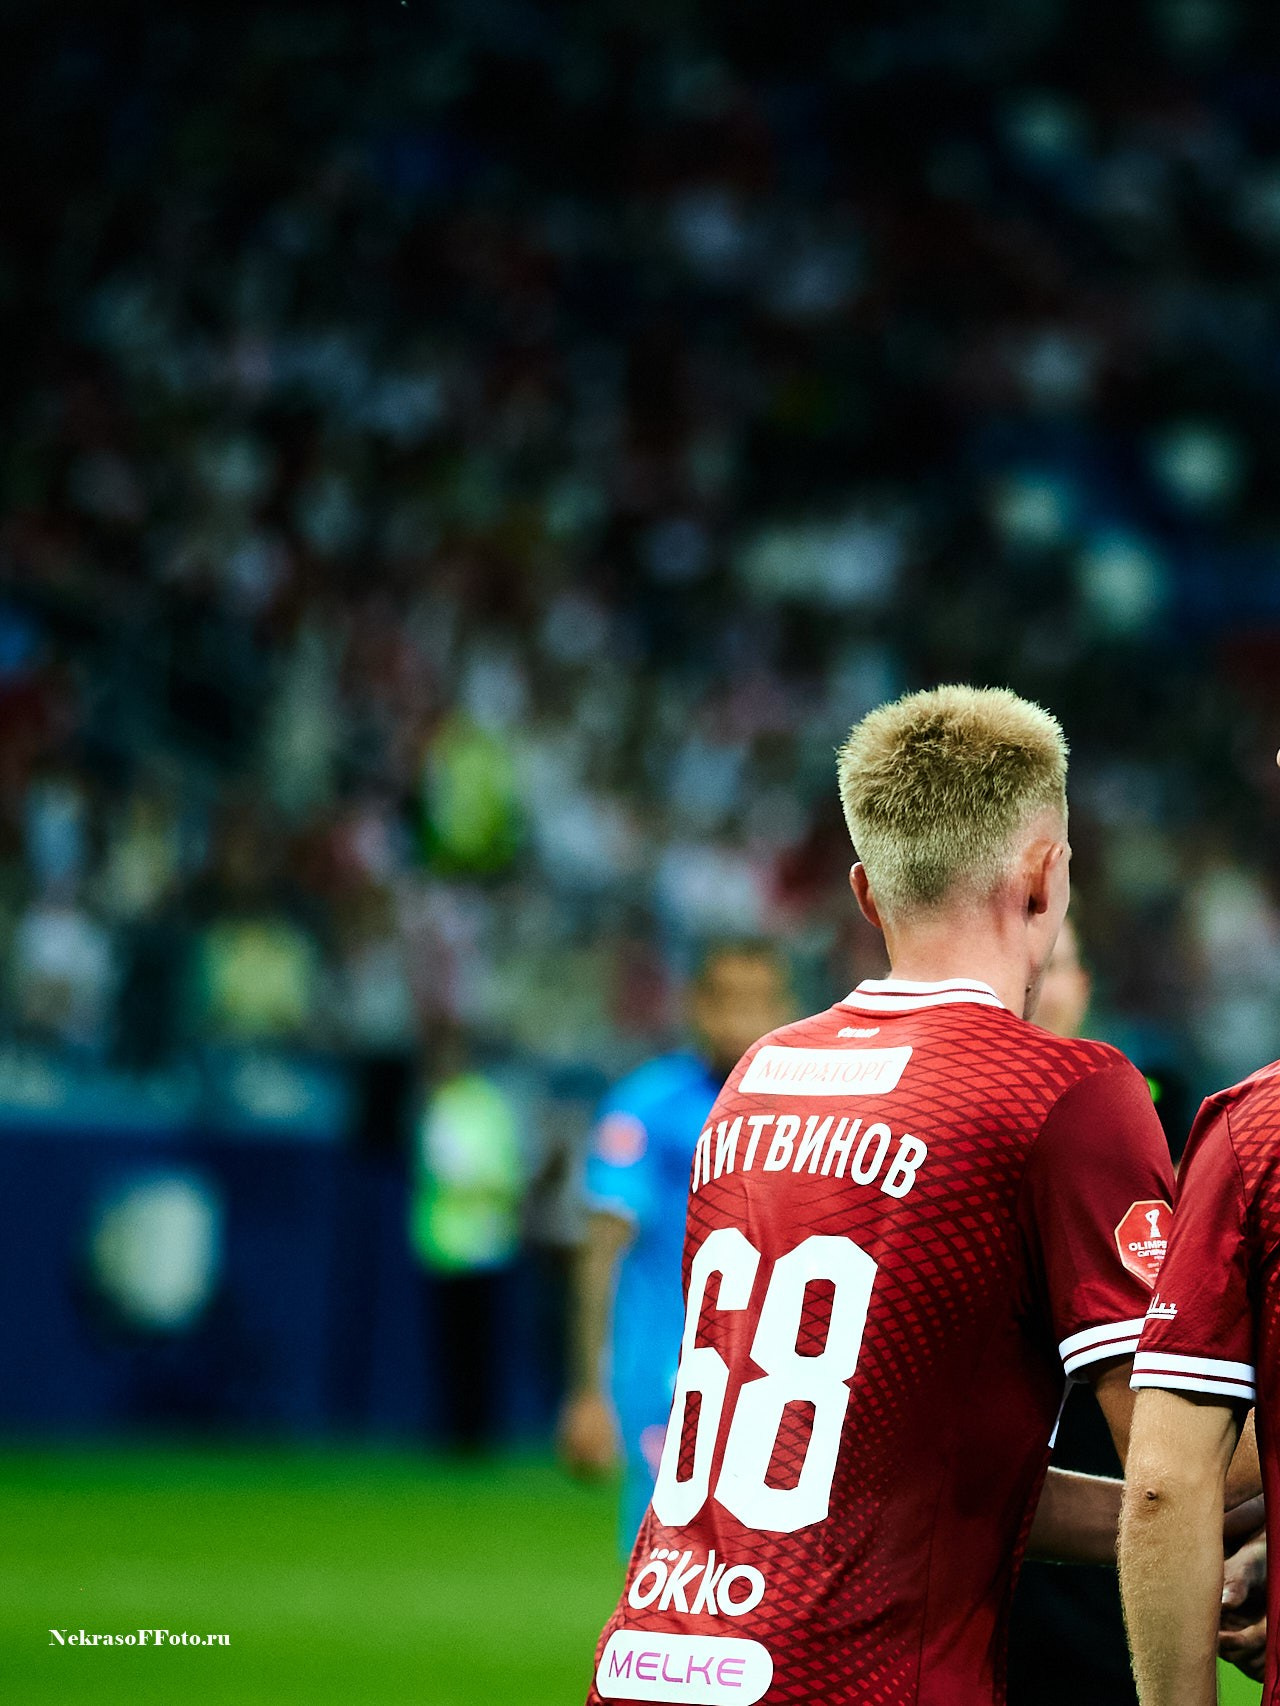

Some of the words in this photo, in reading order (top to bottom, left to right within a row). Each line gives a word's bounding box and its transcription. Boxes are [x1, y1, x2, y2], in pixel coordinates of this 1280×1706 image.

[757, 1059, 893, 1083] МИРАТОРГ
[692, 1114, 928, 1199] ЛИТВИНОВ
[652, 1227, 878, 1534] 68
[608, 1649, 746, 1688] MELKE
